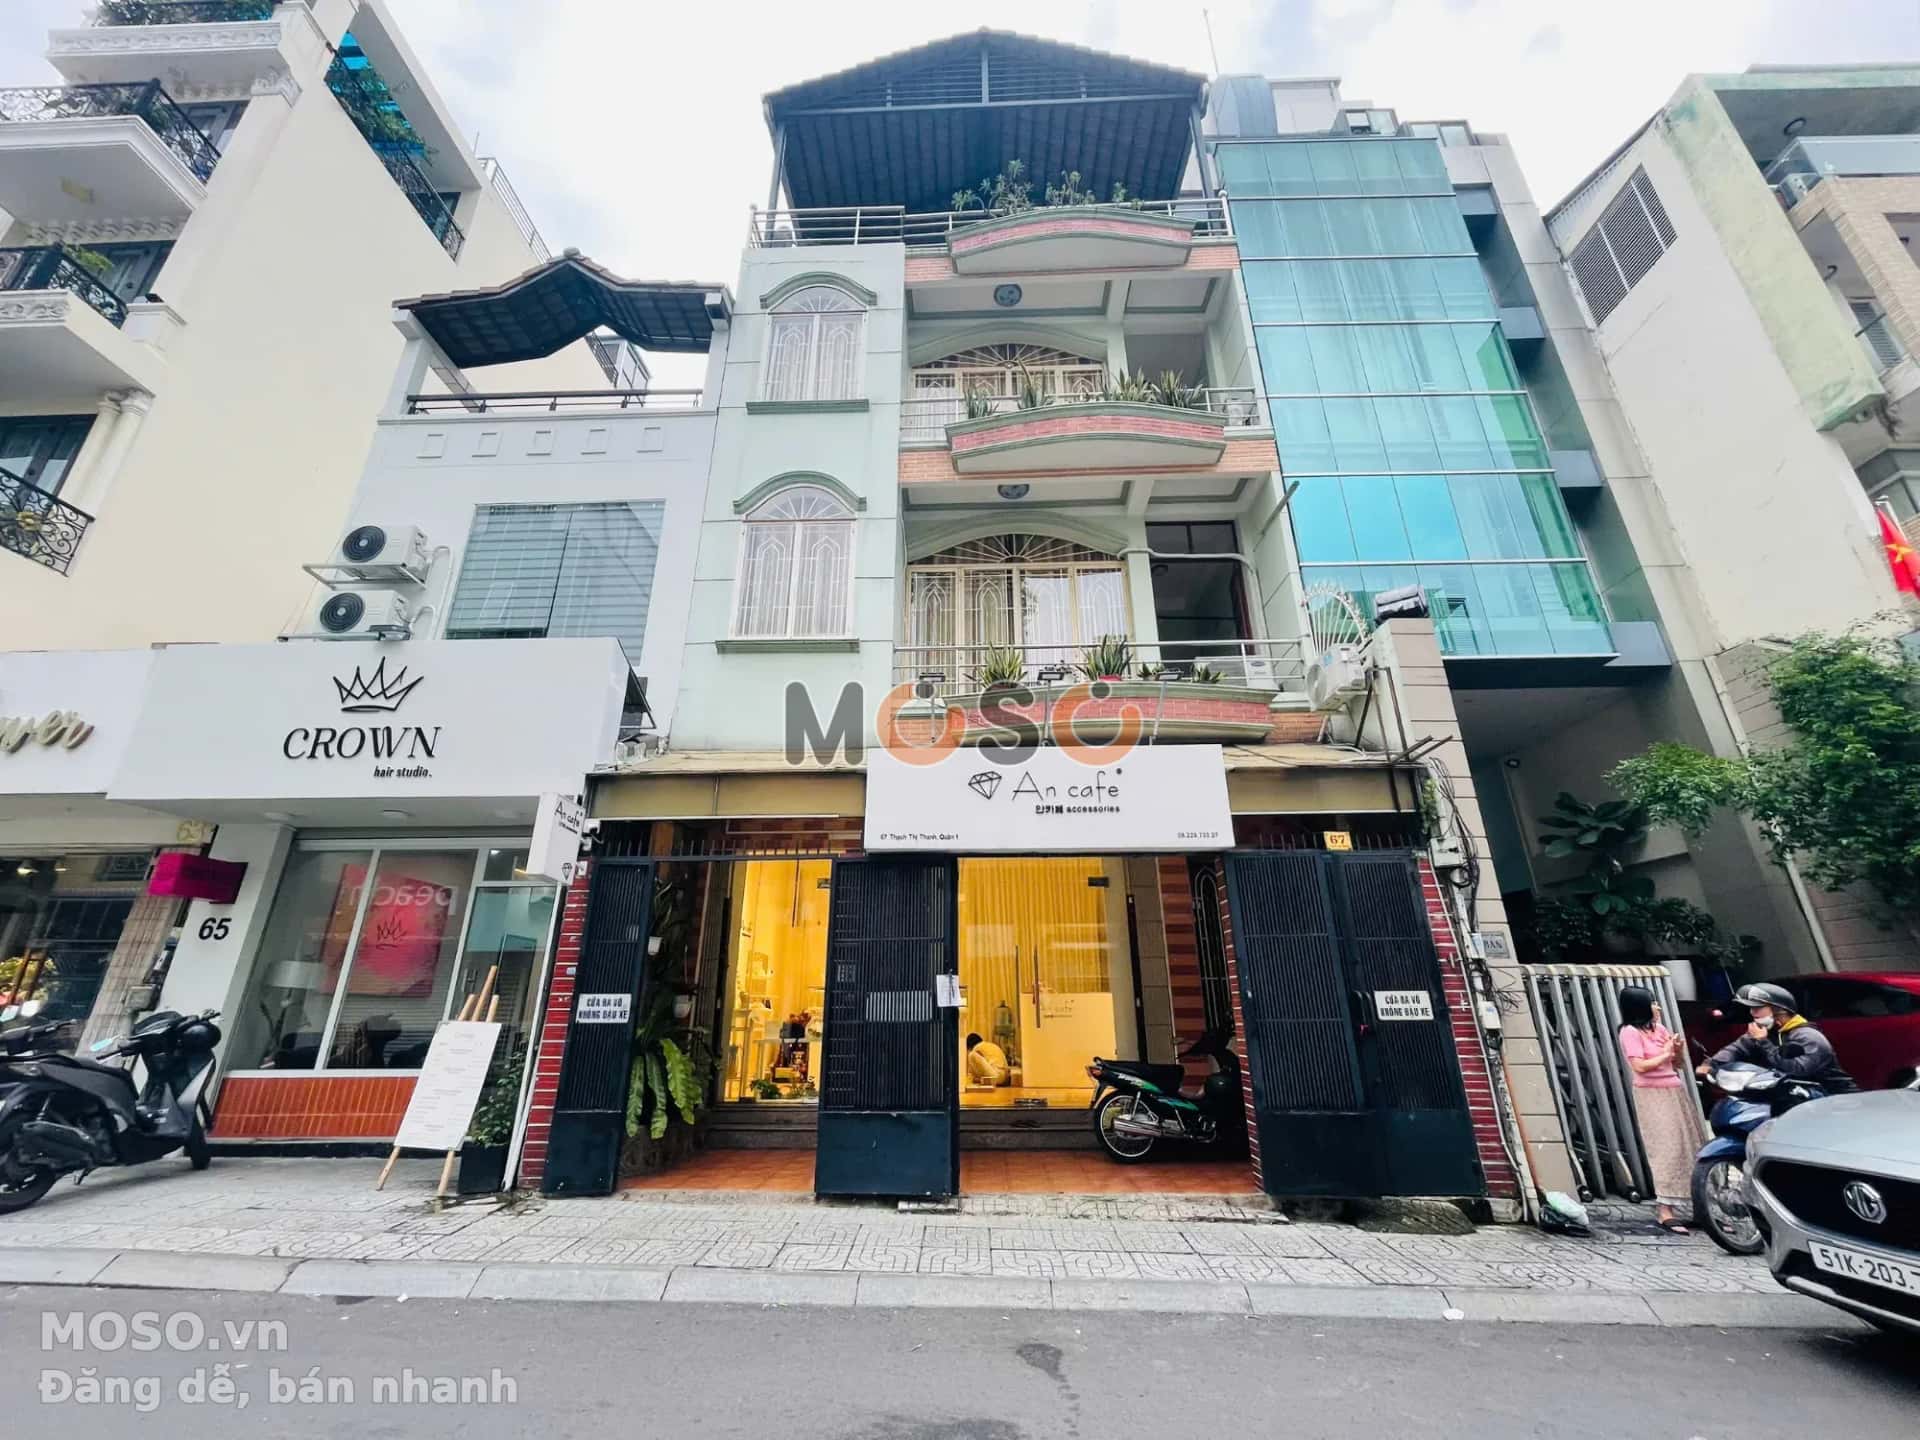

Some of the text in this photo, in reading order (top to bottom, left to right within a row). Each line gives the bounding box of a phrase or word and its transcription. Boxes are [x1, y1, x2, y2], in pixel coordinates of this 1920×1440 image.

[283, 726, 442, 759] CROWN
[373, 766, 394, 777] hair
[1012, 771, 1056, 801] An
[1066, 805, 1120, 813] accessories
[1330, 834, 1345, 844] 67
[198, 917, 232, 941] 65
[1420, 1007, 1431, 1017] XE
[1845, 1182, 1885, 1221] MG
[1819, 1247, 1920, 1291] 51K-203.
